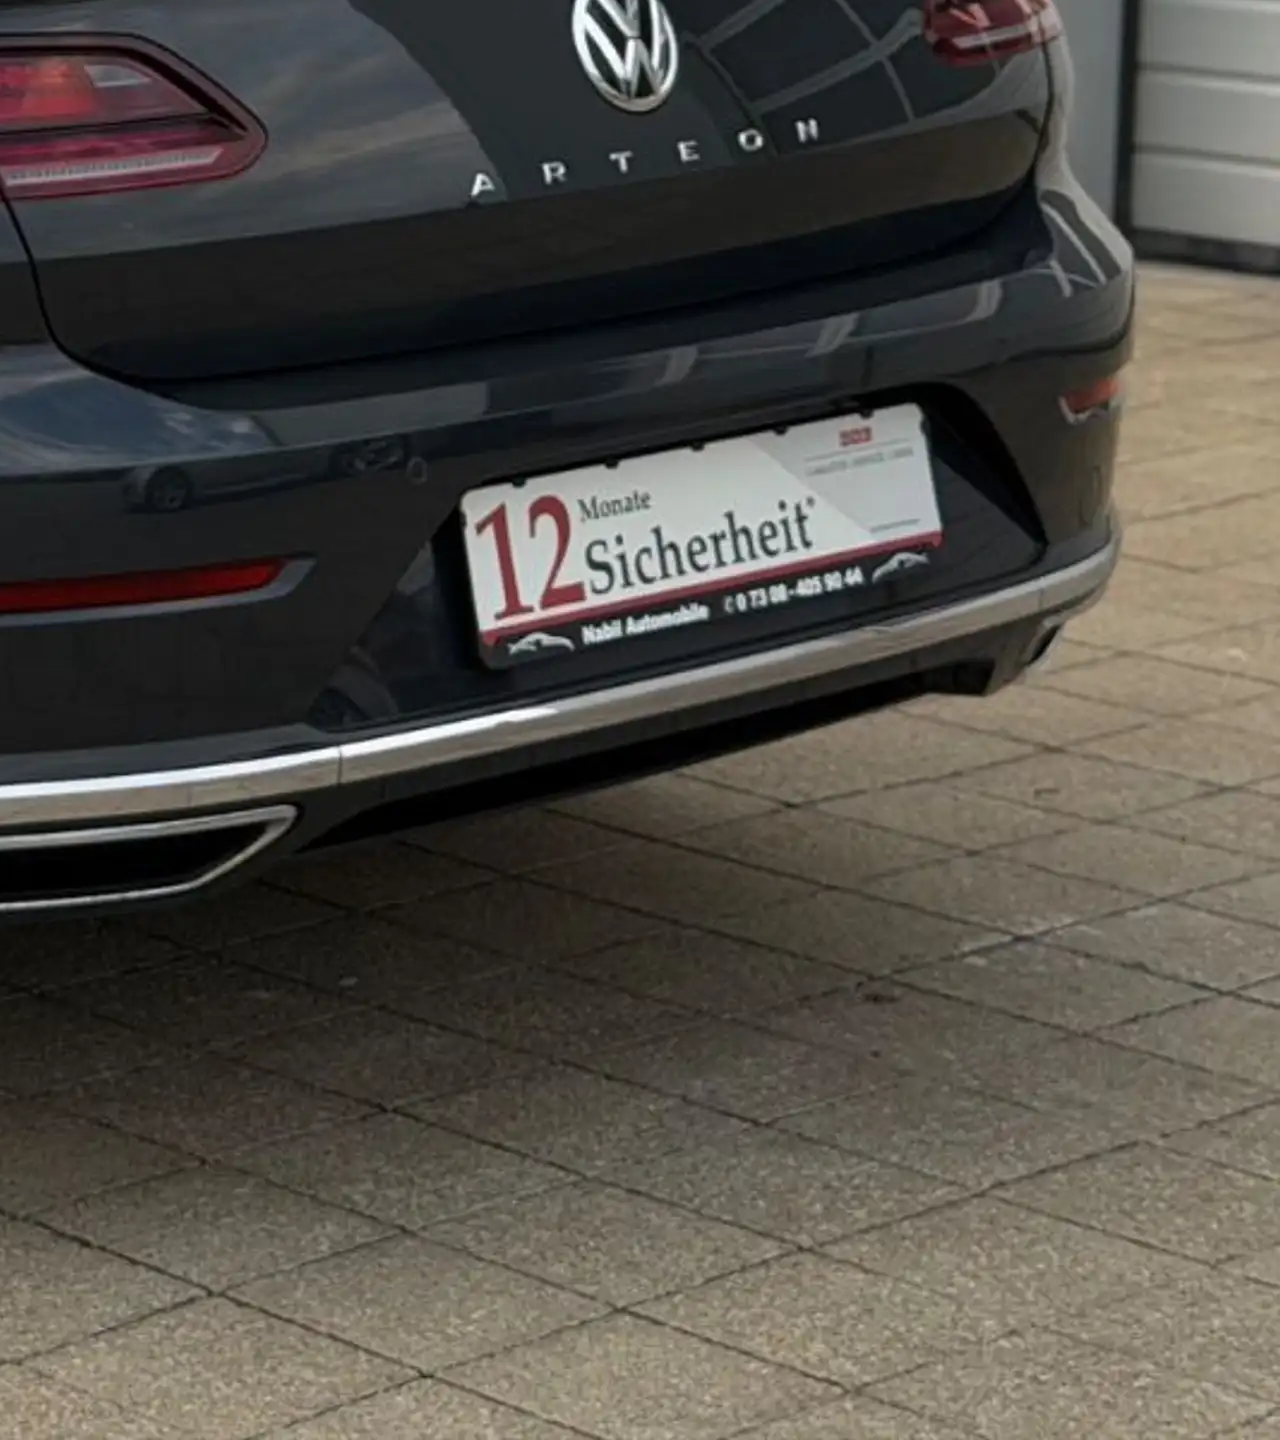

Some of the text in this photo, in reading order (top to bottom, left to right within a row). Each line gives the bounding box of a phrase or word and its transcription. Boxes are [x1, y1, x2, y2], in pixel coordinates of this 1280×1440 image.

[469, 116, 820, 198] ARTEON
[577, 489, 652, 523] Monate
[474, 494, 587, 621] 12
[625, 601, 710, 636] Automobile
